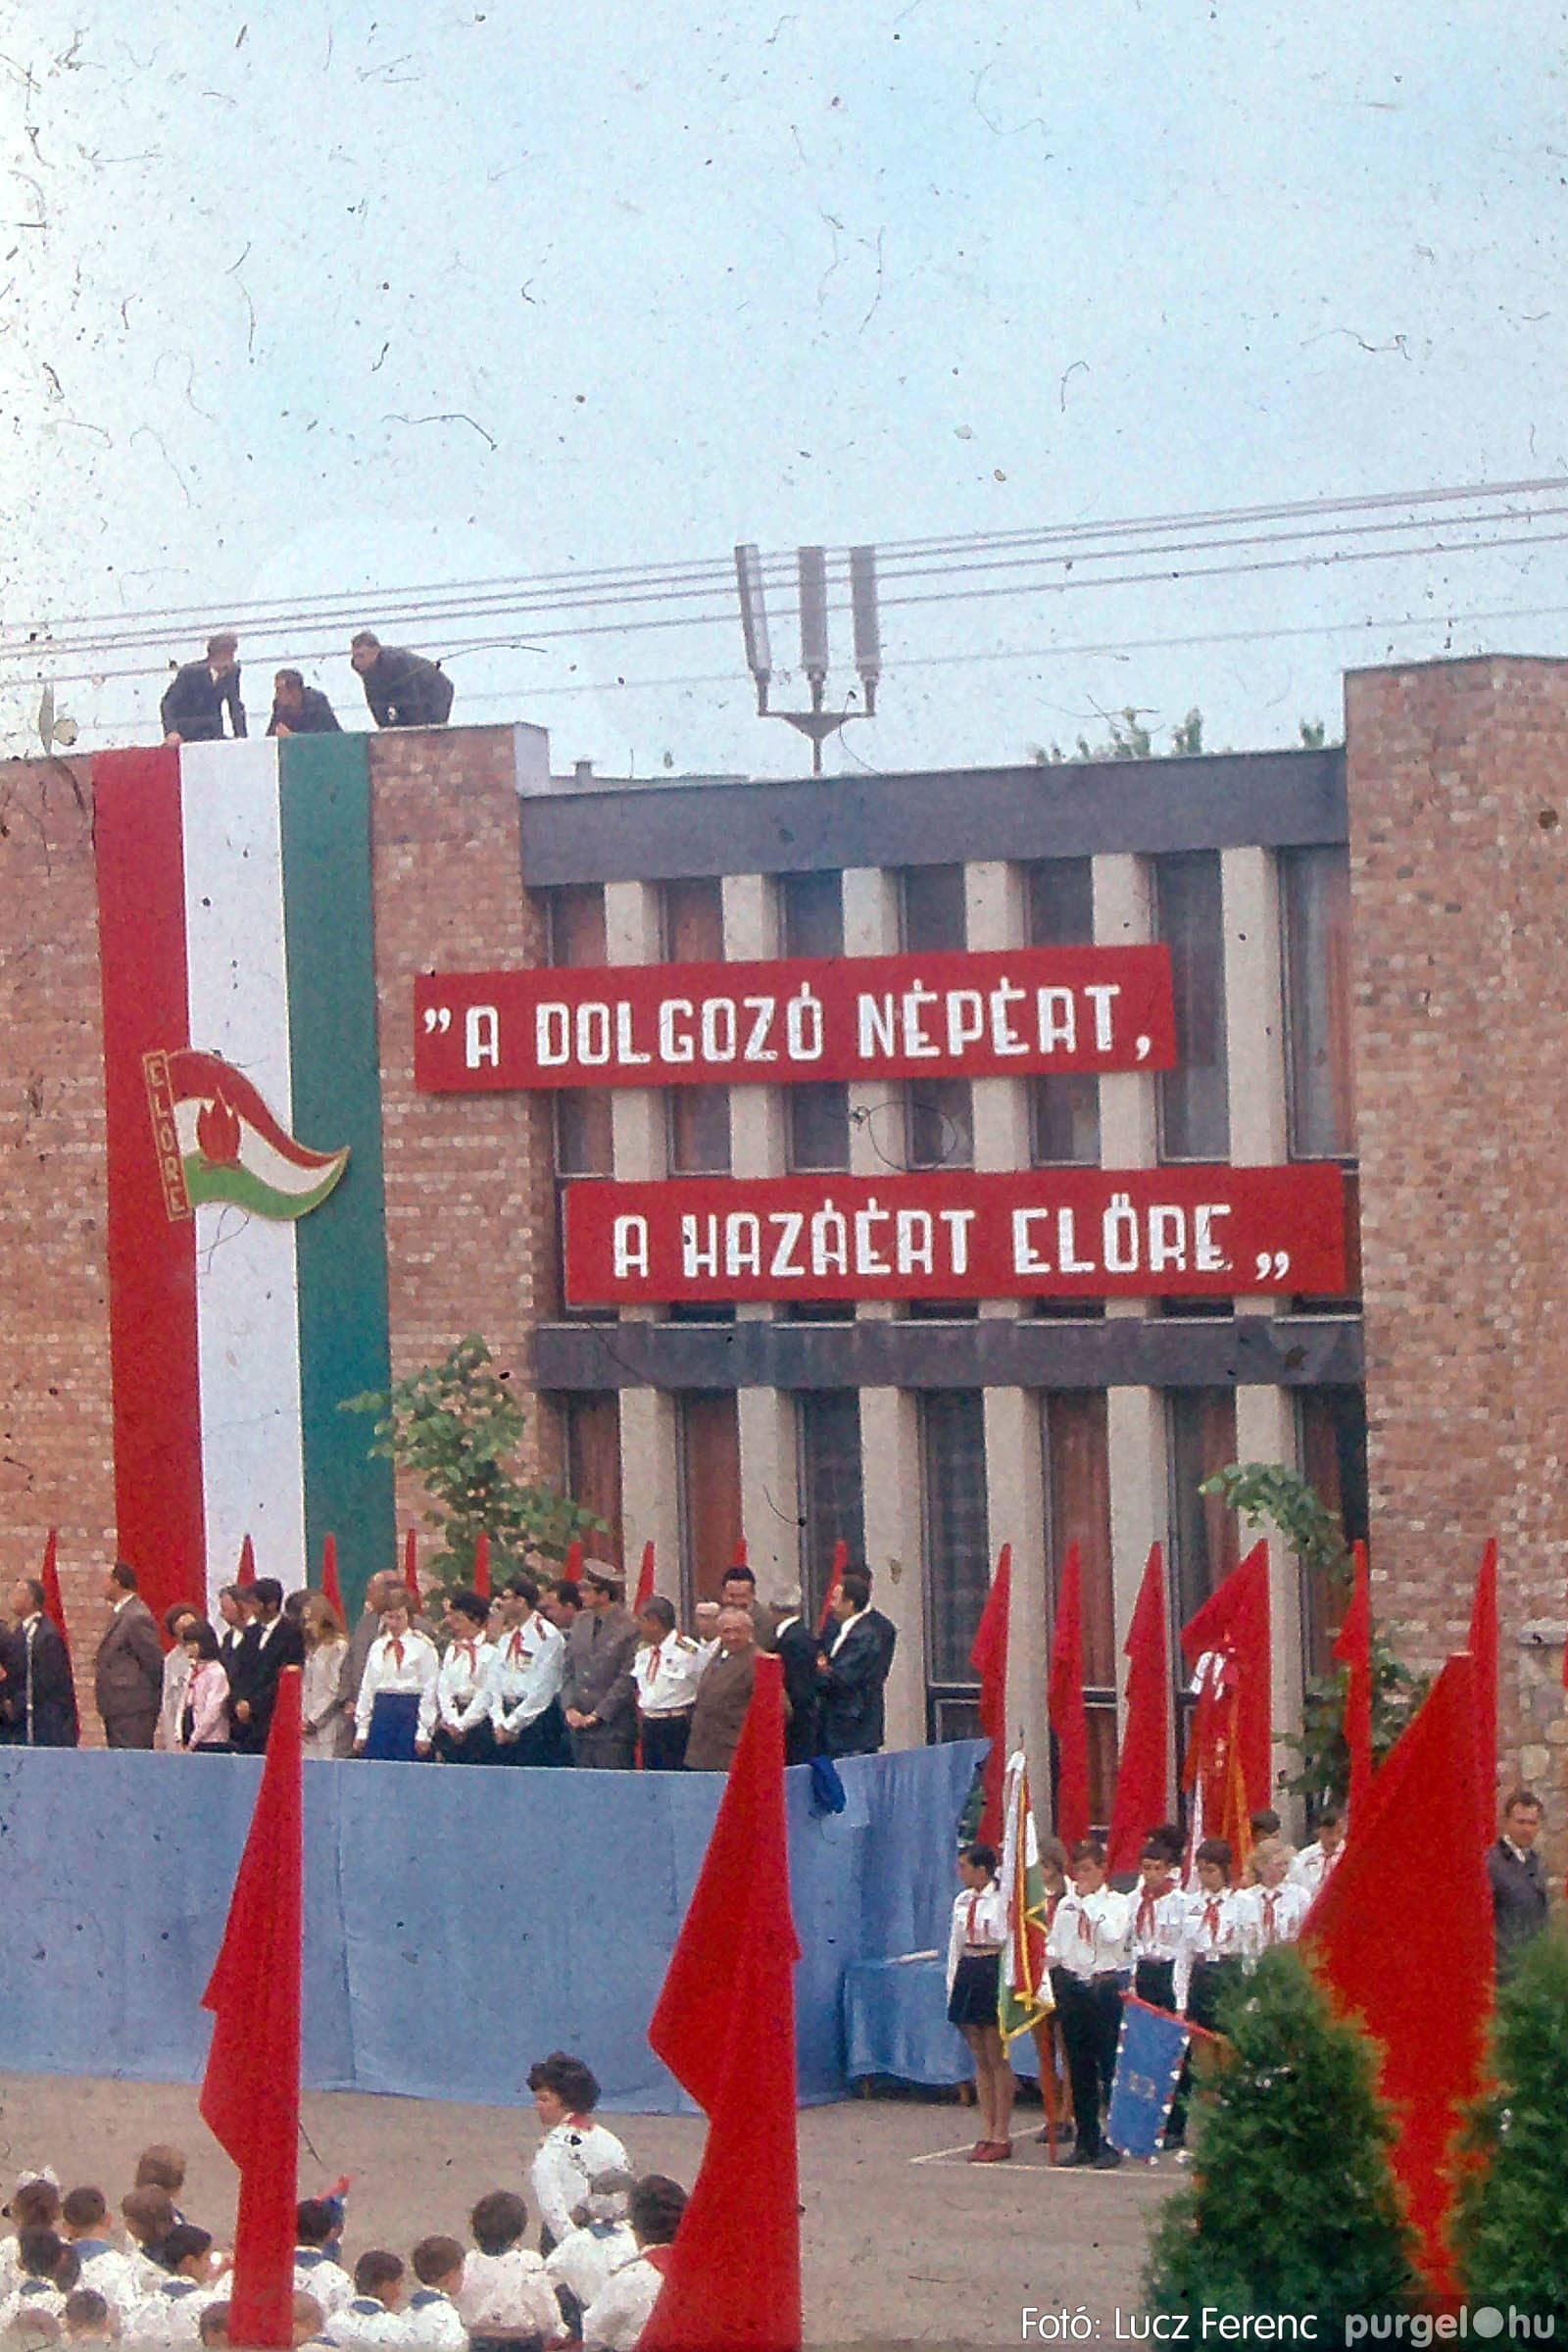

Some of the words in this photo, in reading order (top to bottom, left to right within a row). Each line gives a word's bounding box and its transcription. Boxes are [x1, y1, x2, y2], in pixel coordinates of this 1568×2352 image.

[535, 981, 823, 1066] DOLGOZÓ
[858, 976, 1151, 1060] NÉPÉRT,
[613, 1214, 649, 1278] A
[681, 1198, 975, 1278] HAZÁÉRT
